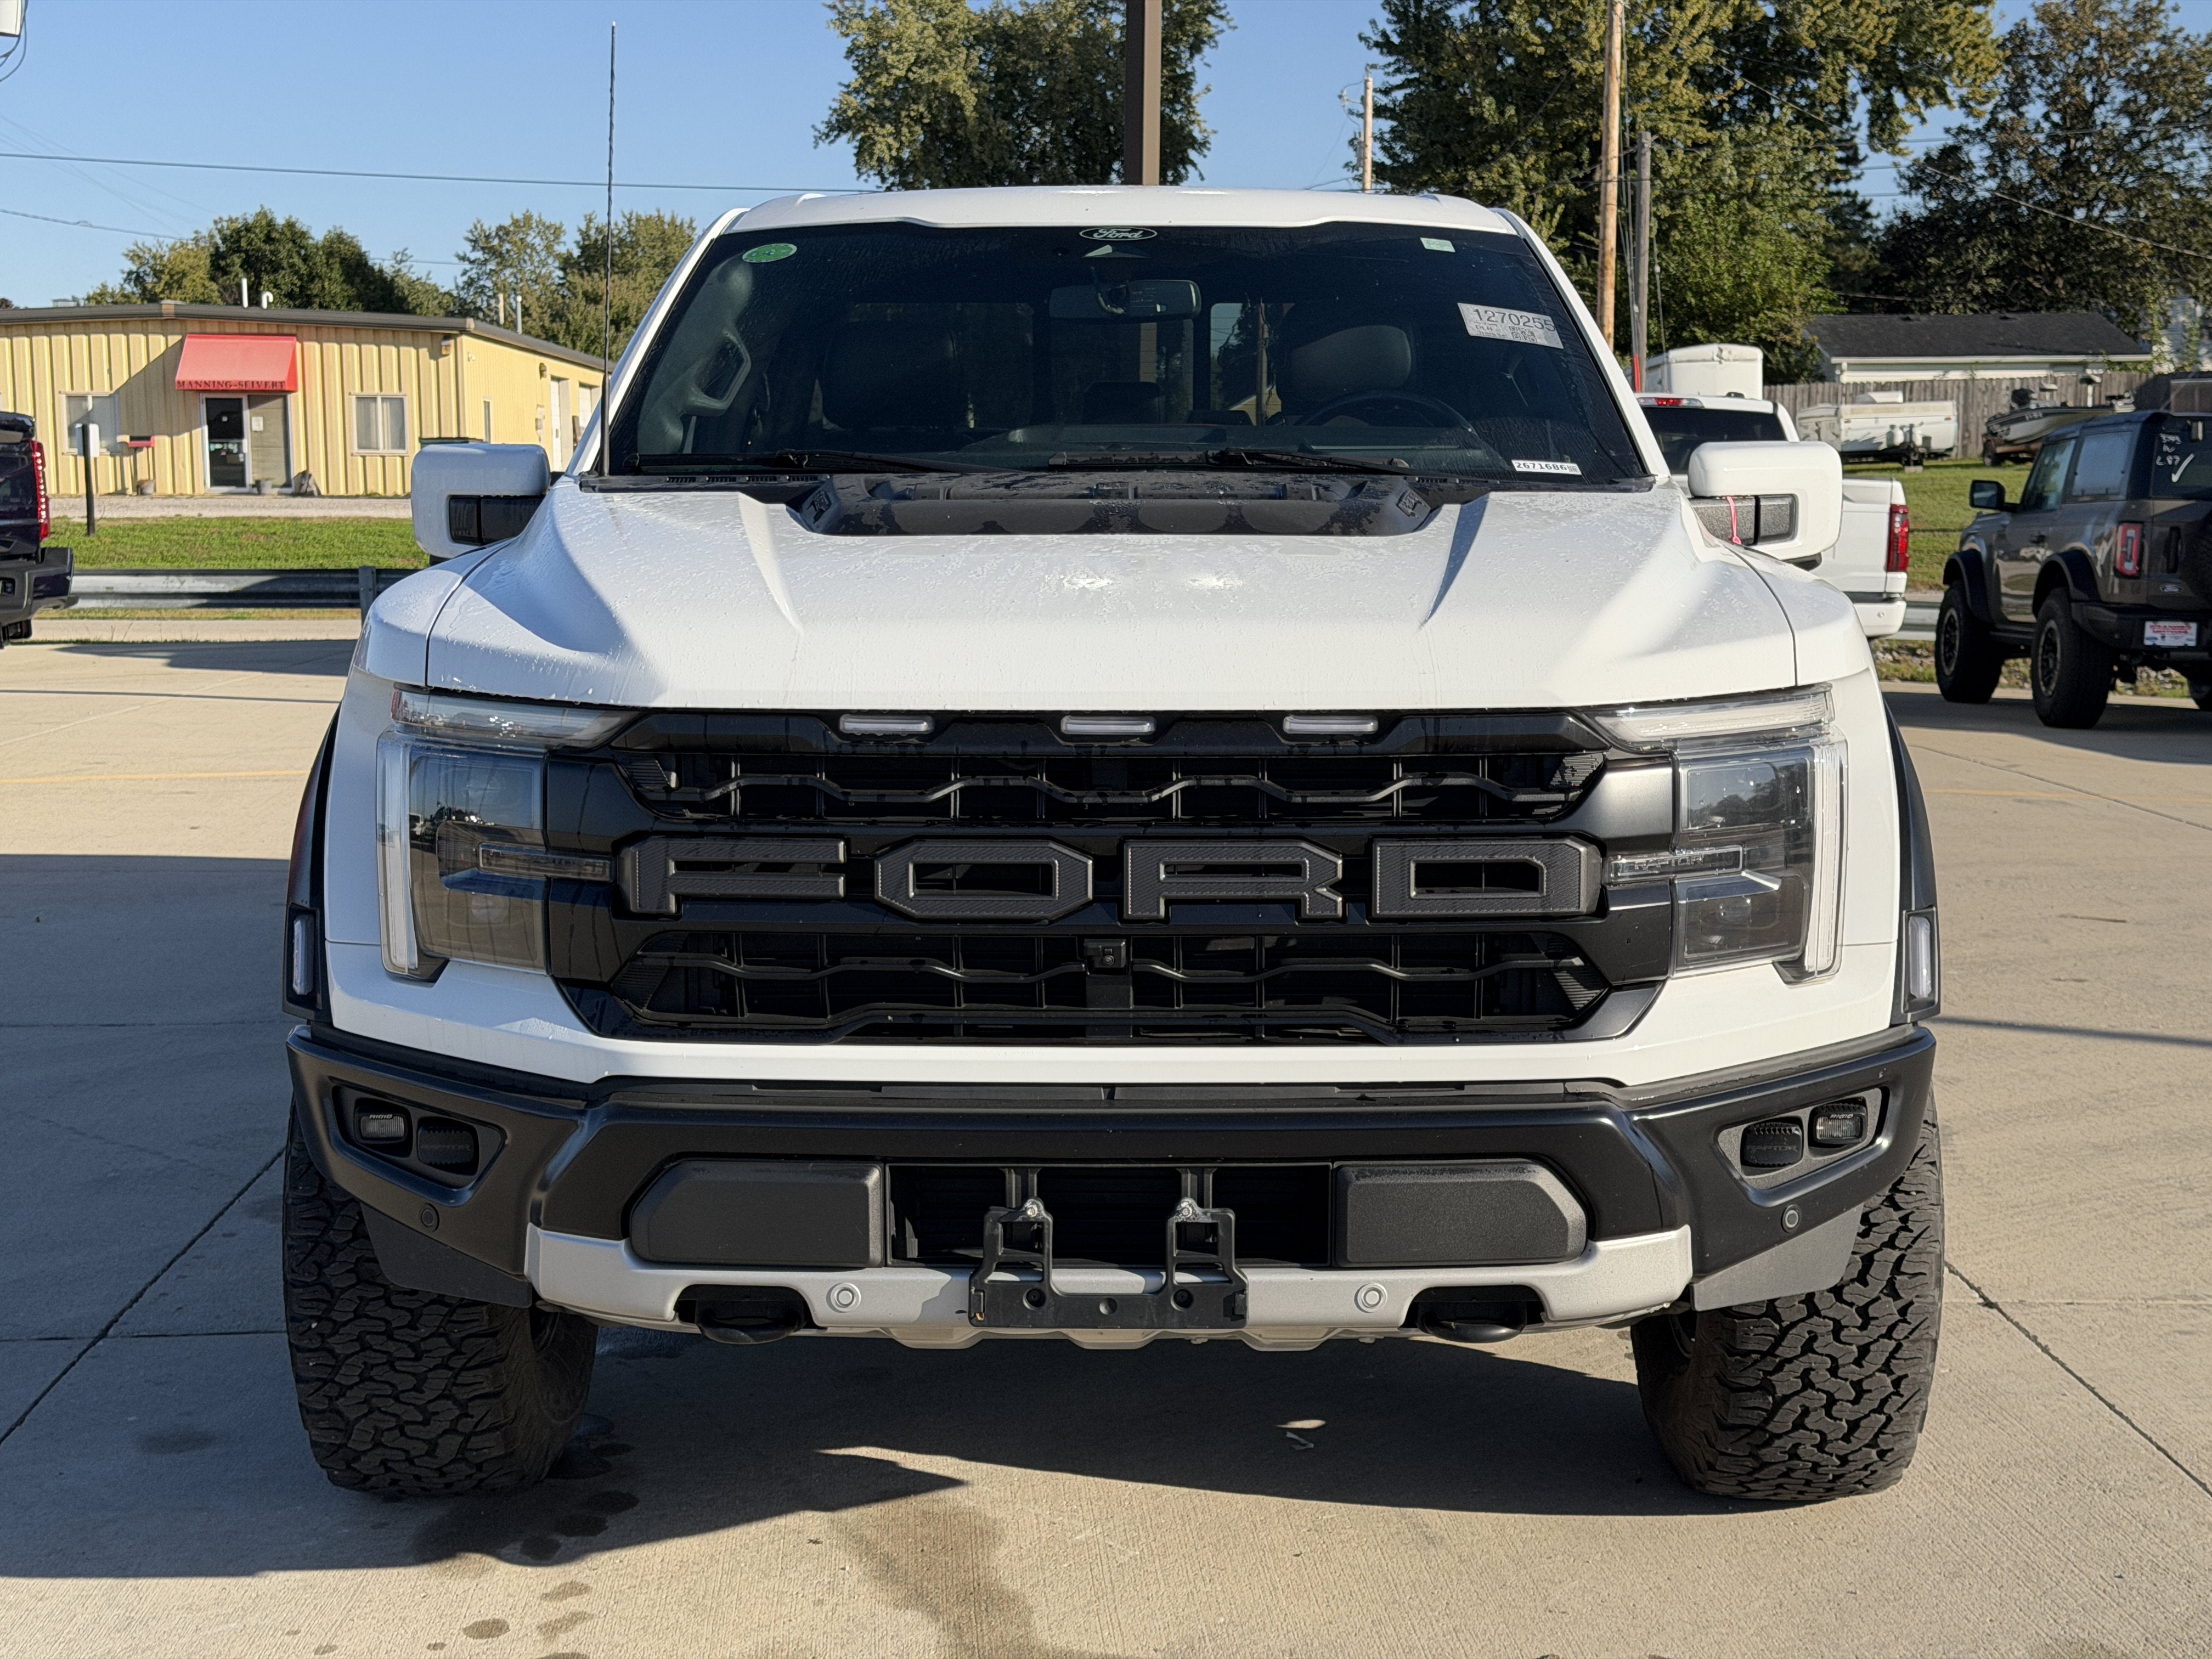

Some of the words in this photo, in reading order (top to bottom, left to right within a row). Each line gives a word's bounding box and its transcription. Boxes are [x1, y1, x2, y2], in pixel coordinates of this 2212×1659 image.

[1093, 228, 1143, 239] Ford
[1474, 309, 1556, 332] 1270255
[1515, 462, 1567, 471] 2671686
[619, 834, 1601, 921] FORD
